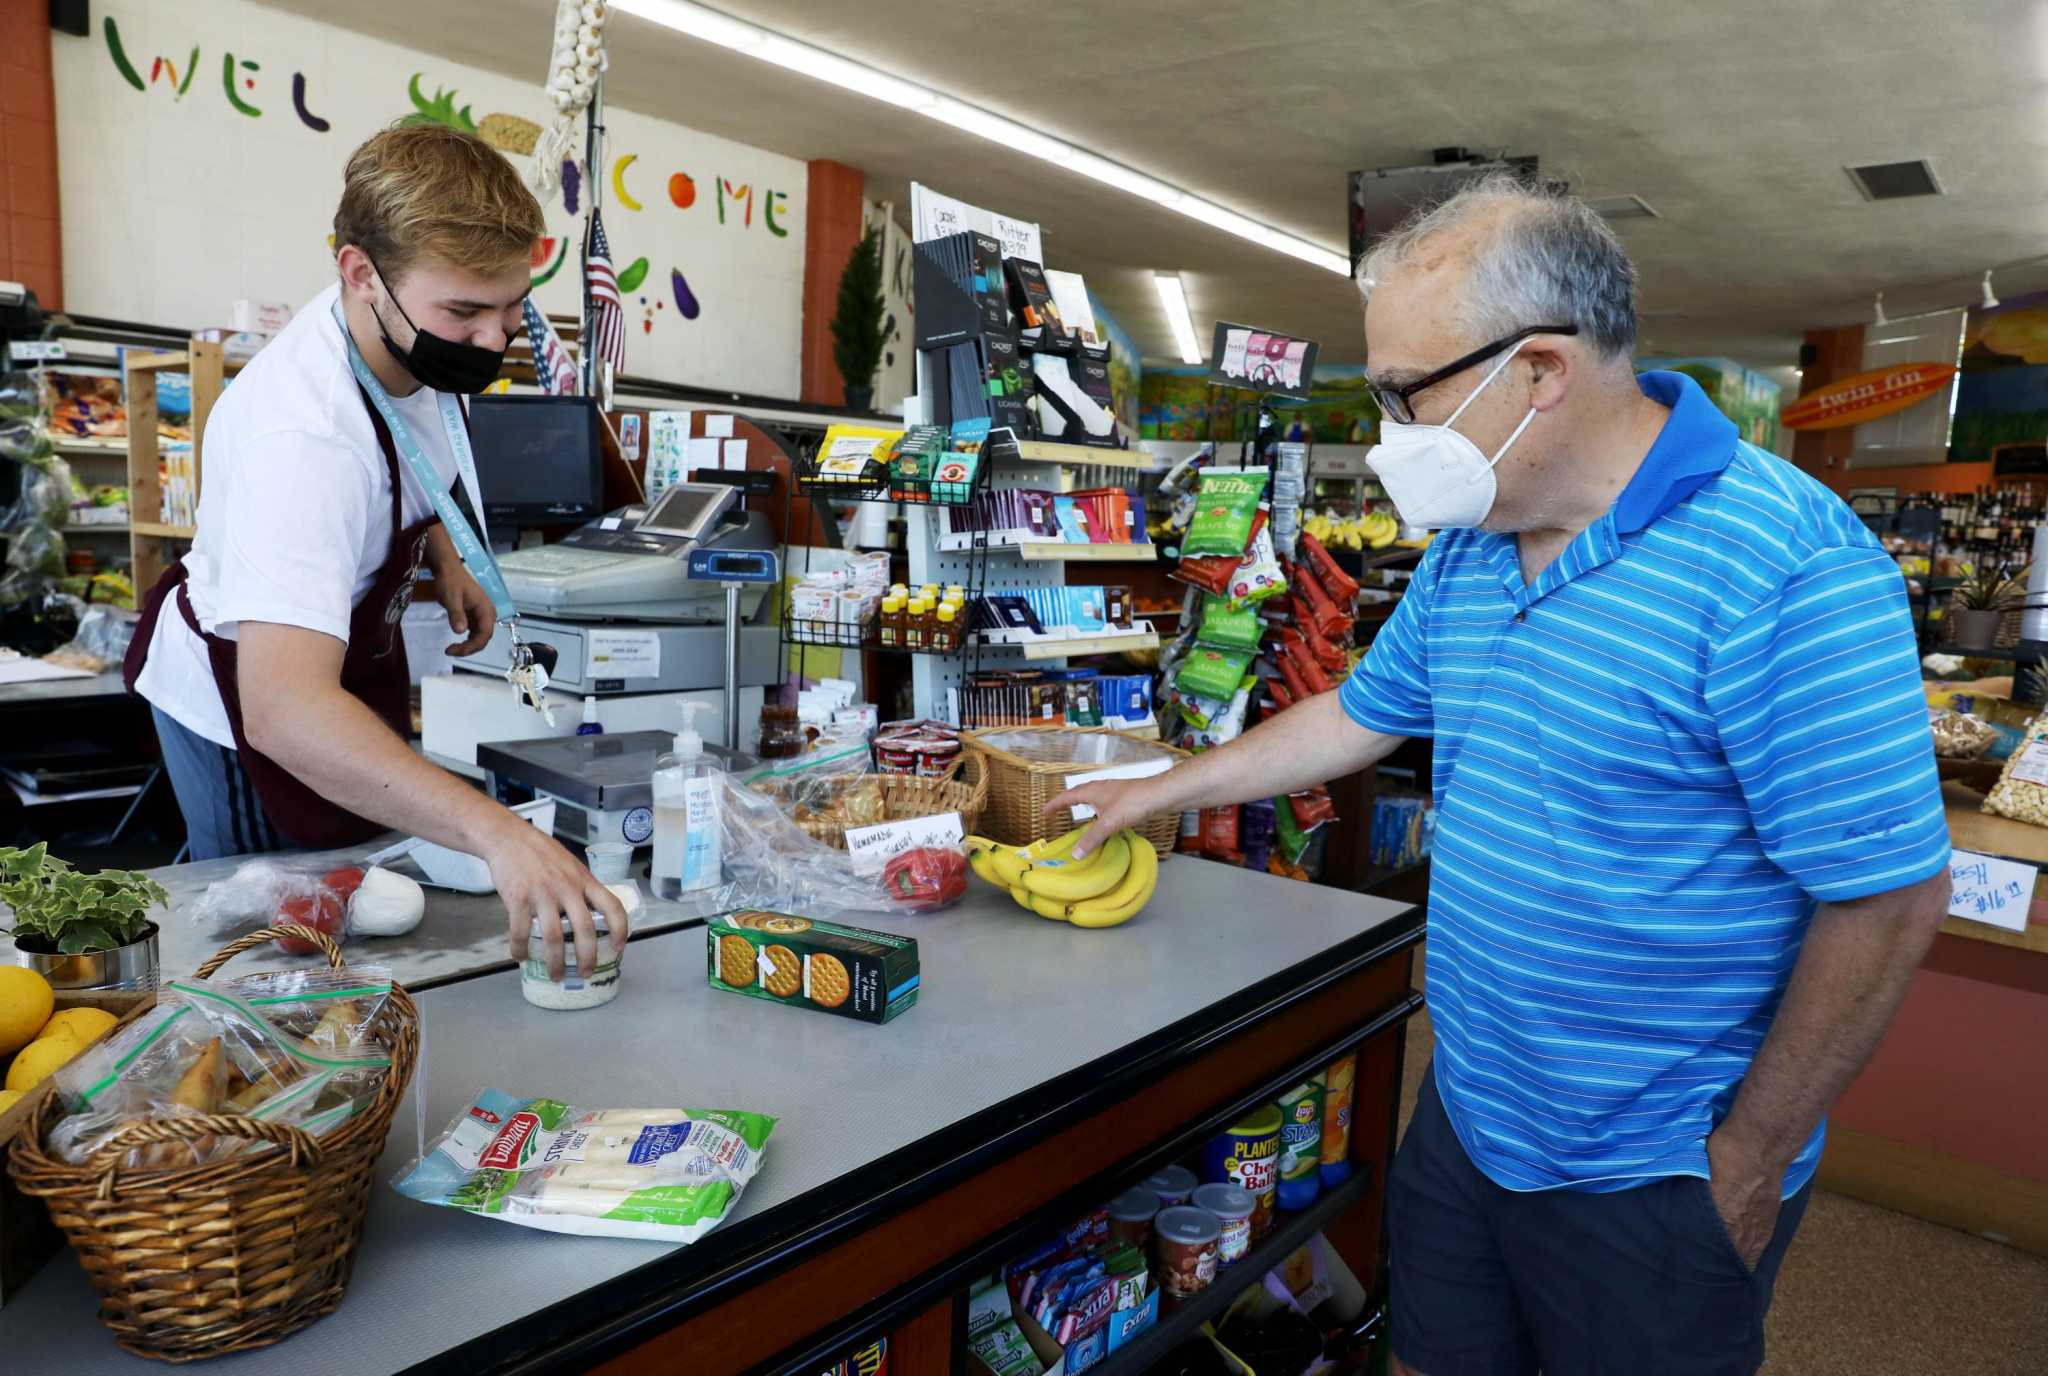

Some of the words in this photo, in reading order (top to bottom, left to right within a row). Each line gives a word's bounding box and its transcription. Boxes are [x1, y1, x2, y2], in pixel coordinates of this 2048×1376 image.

[1819, 383, 1876, 409] twin
[1884, 371, 1921, 390] fin
[1951, 863, 1988, 885] ESH
[487, 1117, 531, 1163] Galbani
[544, 1129, 578, 1163] STRING
[1280, 1120, 1320, 1142] STAX
[1234, 1138, 1279, 1159] PLANTE
[1121, 1303, 1152, 1337] Extra
